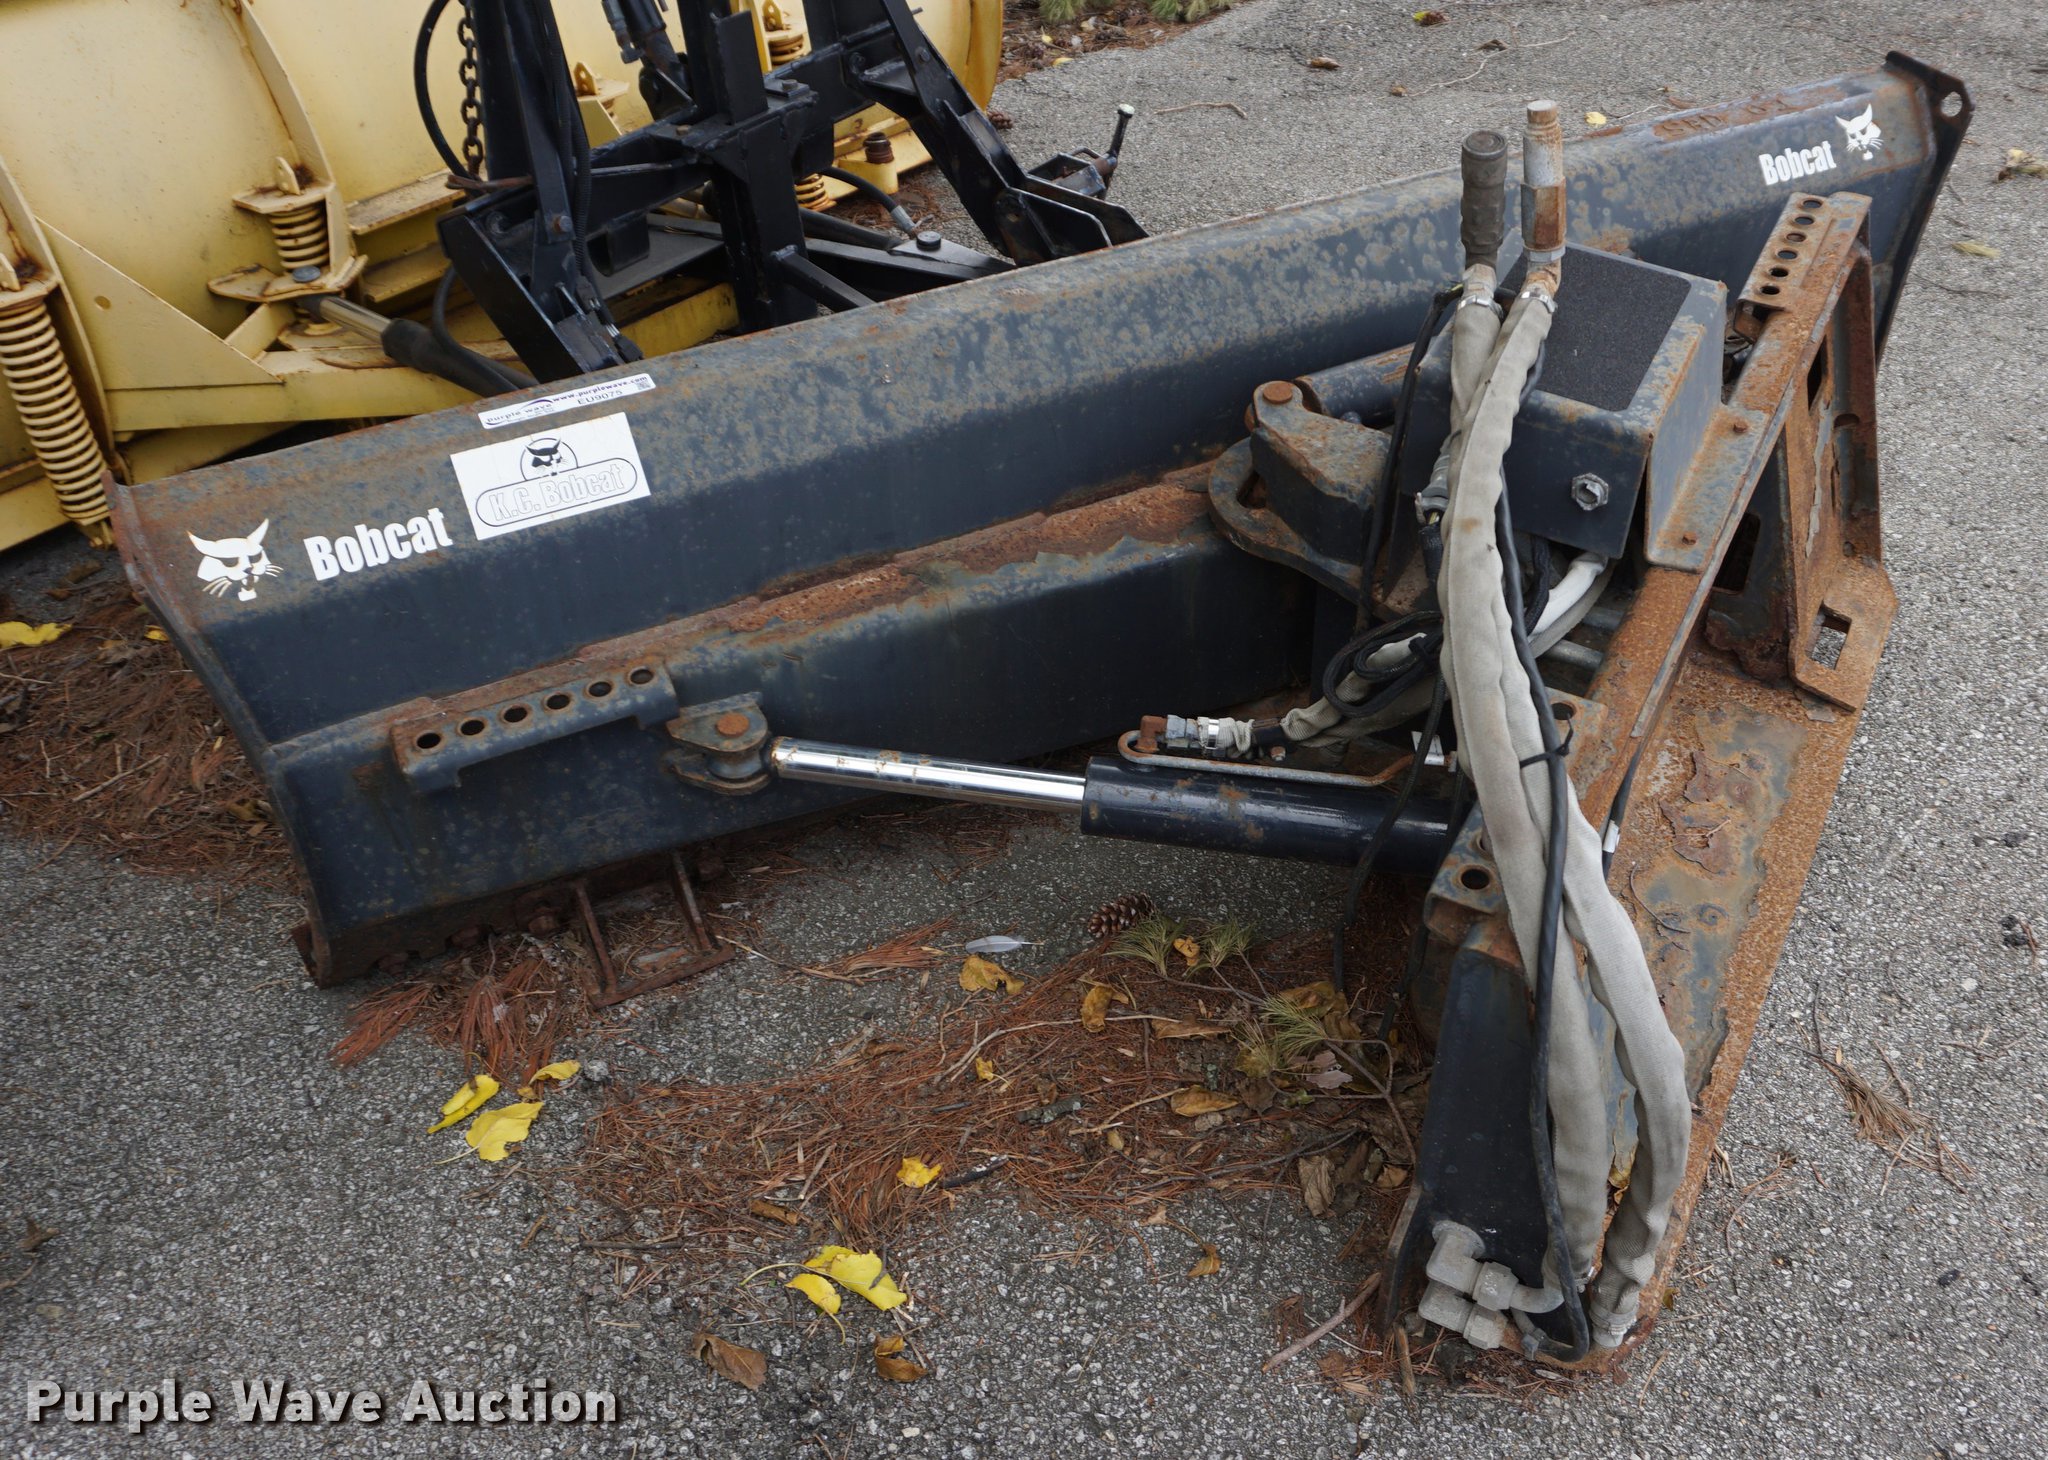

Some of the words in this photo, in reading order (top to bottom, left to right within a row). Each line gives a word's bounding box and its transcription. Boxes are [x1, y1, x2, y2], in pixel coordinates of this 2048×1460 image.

[1758, 140, 1837, 186] Bobcat
[551, 374, 649, 402] www.purplewave.com
[577, 390, 624, 405] EU9075
[489, 486, 541, 522] K.C.
[539, 463, 625, 508] Bobcat
[303, 507, 454, 581] Bobcat
